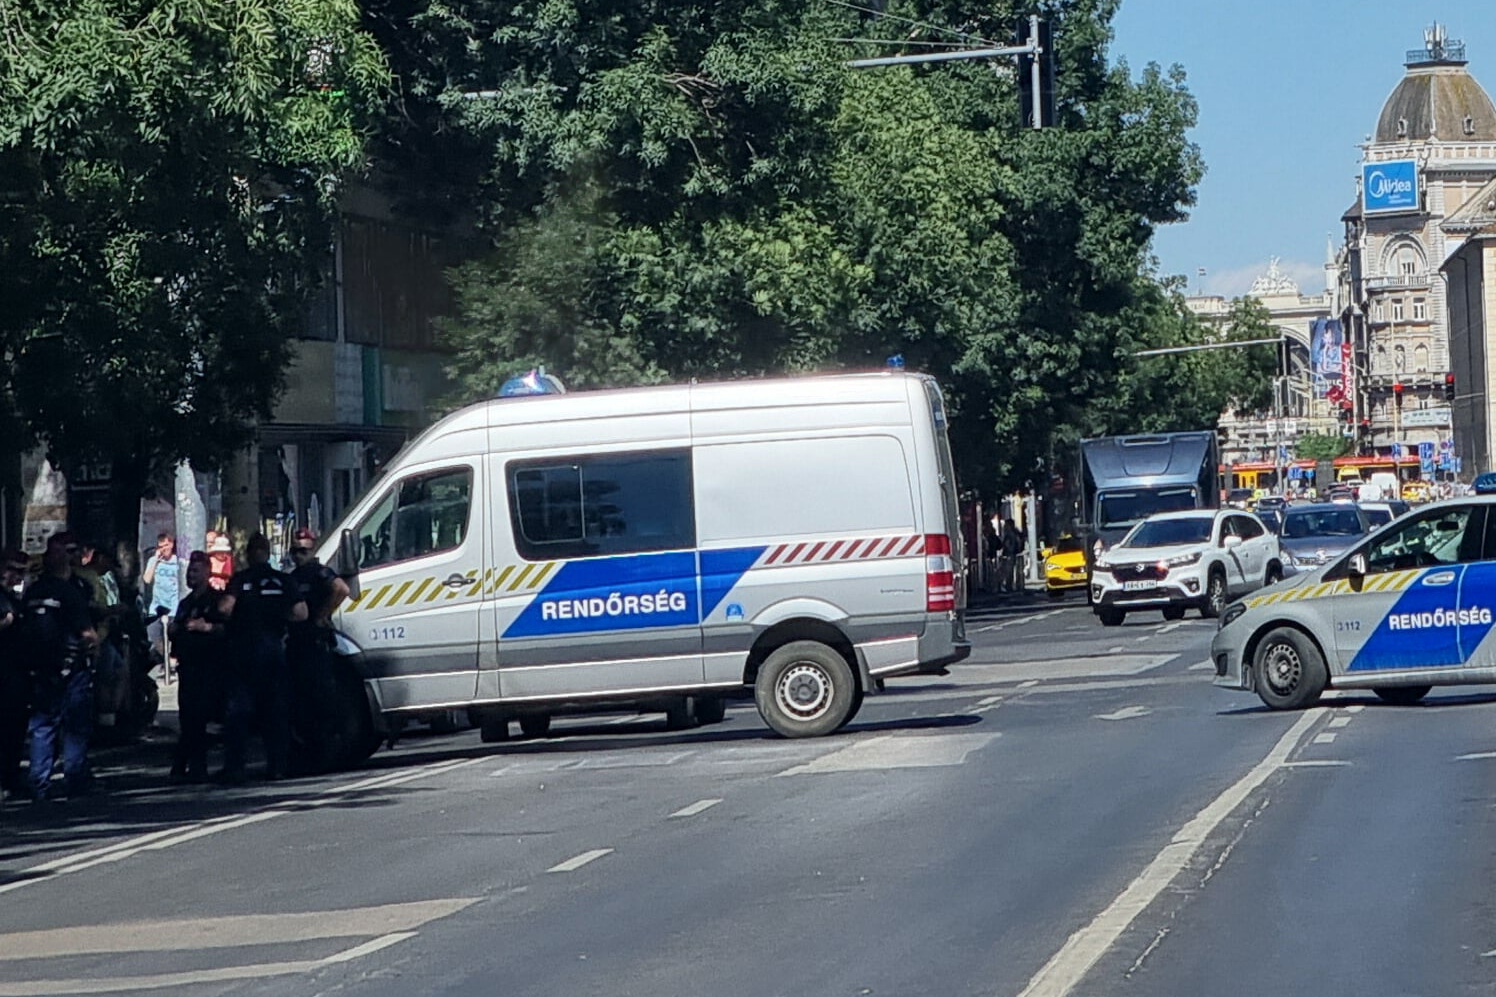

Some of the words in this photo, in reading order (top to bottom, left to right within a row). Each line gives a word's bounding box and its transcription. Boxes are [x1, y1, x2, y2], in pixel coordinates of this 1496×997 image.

[1369, 171, 1411, 198] Midea
[541, 590, 686, 621] RENDŐRSÉG
[1345, 621, 1360, 631] 112
[1388, 606, 1491, 630] RENDŐRSÉG
[382, 627, 404, 640] 112
